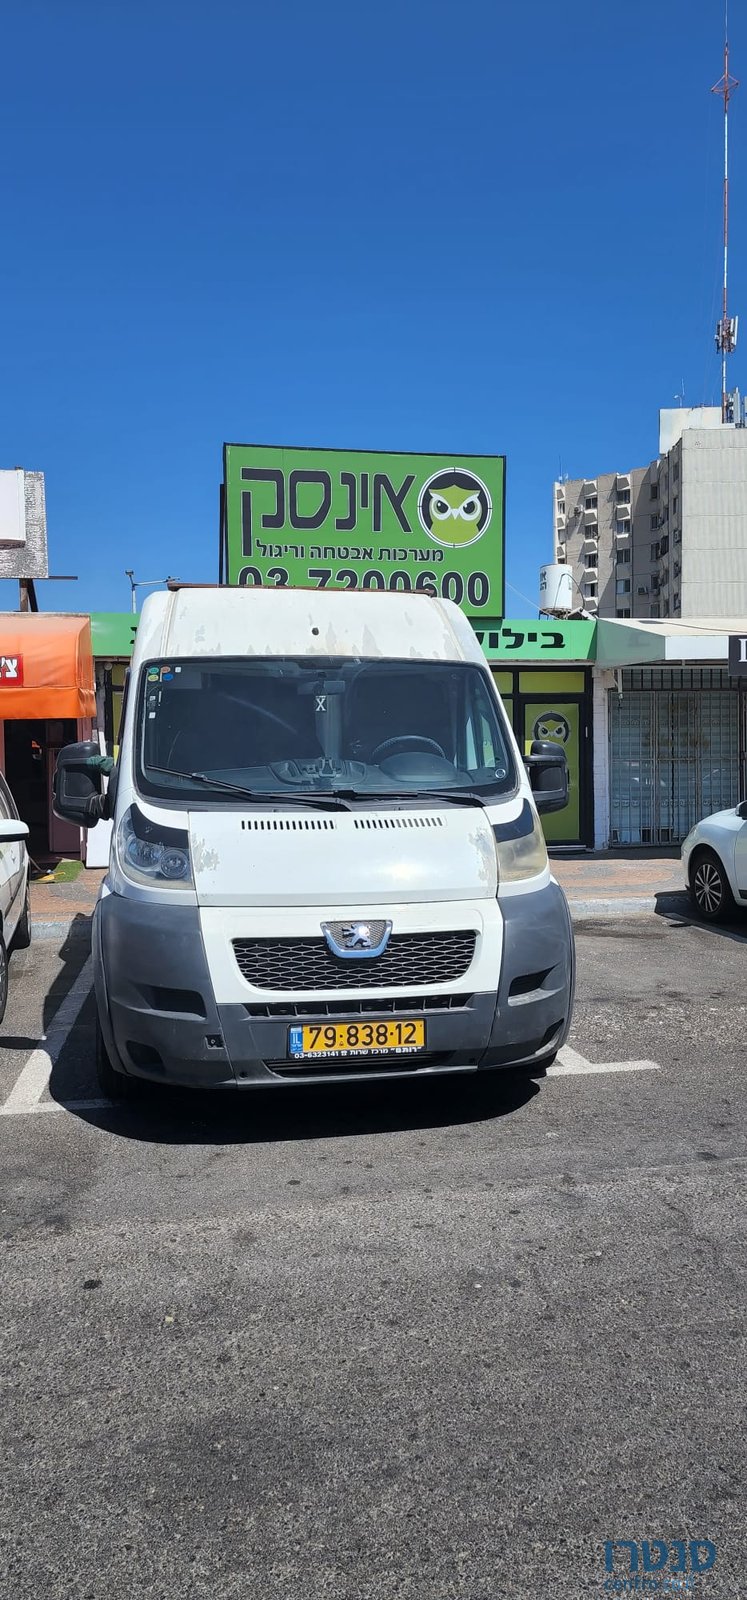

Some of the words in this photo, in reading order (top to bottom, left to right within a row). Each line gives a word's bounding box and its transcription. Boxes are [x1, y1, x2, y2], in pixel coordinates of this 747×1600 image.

[241, 467, 417, 557] אינסק
[256, 539, 305, 558] וריגול
[310, 545, 373, 561] אבטחה
[378, 548, 444, 562] מערכות
